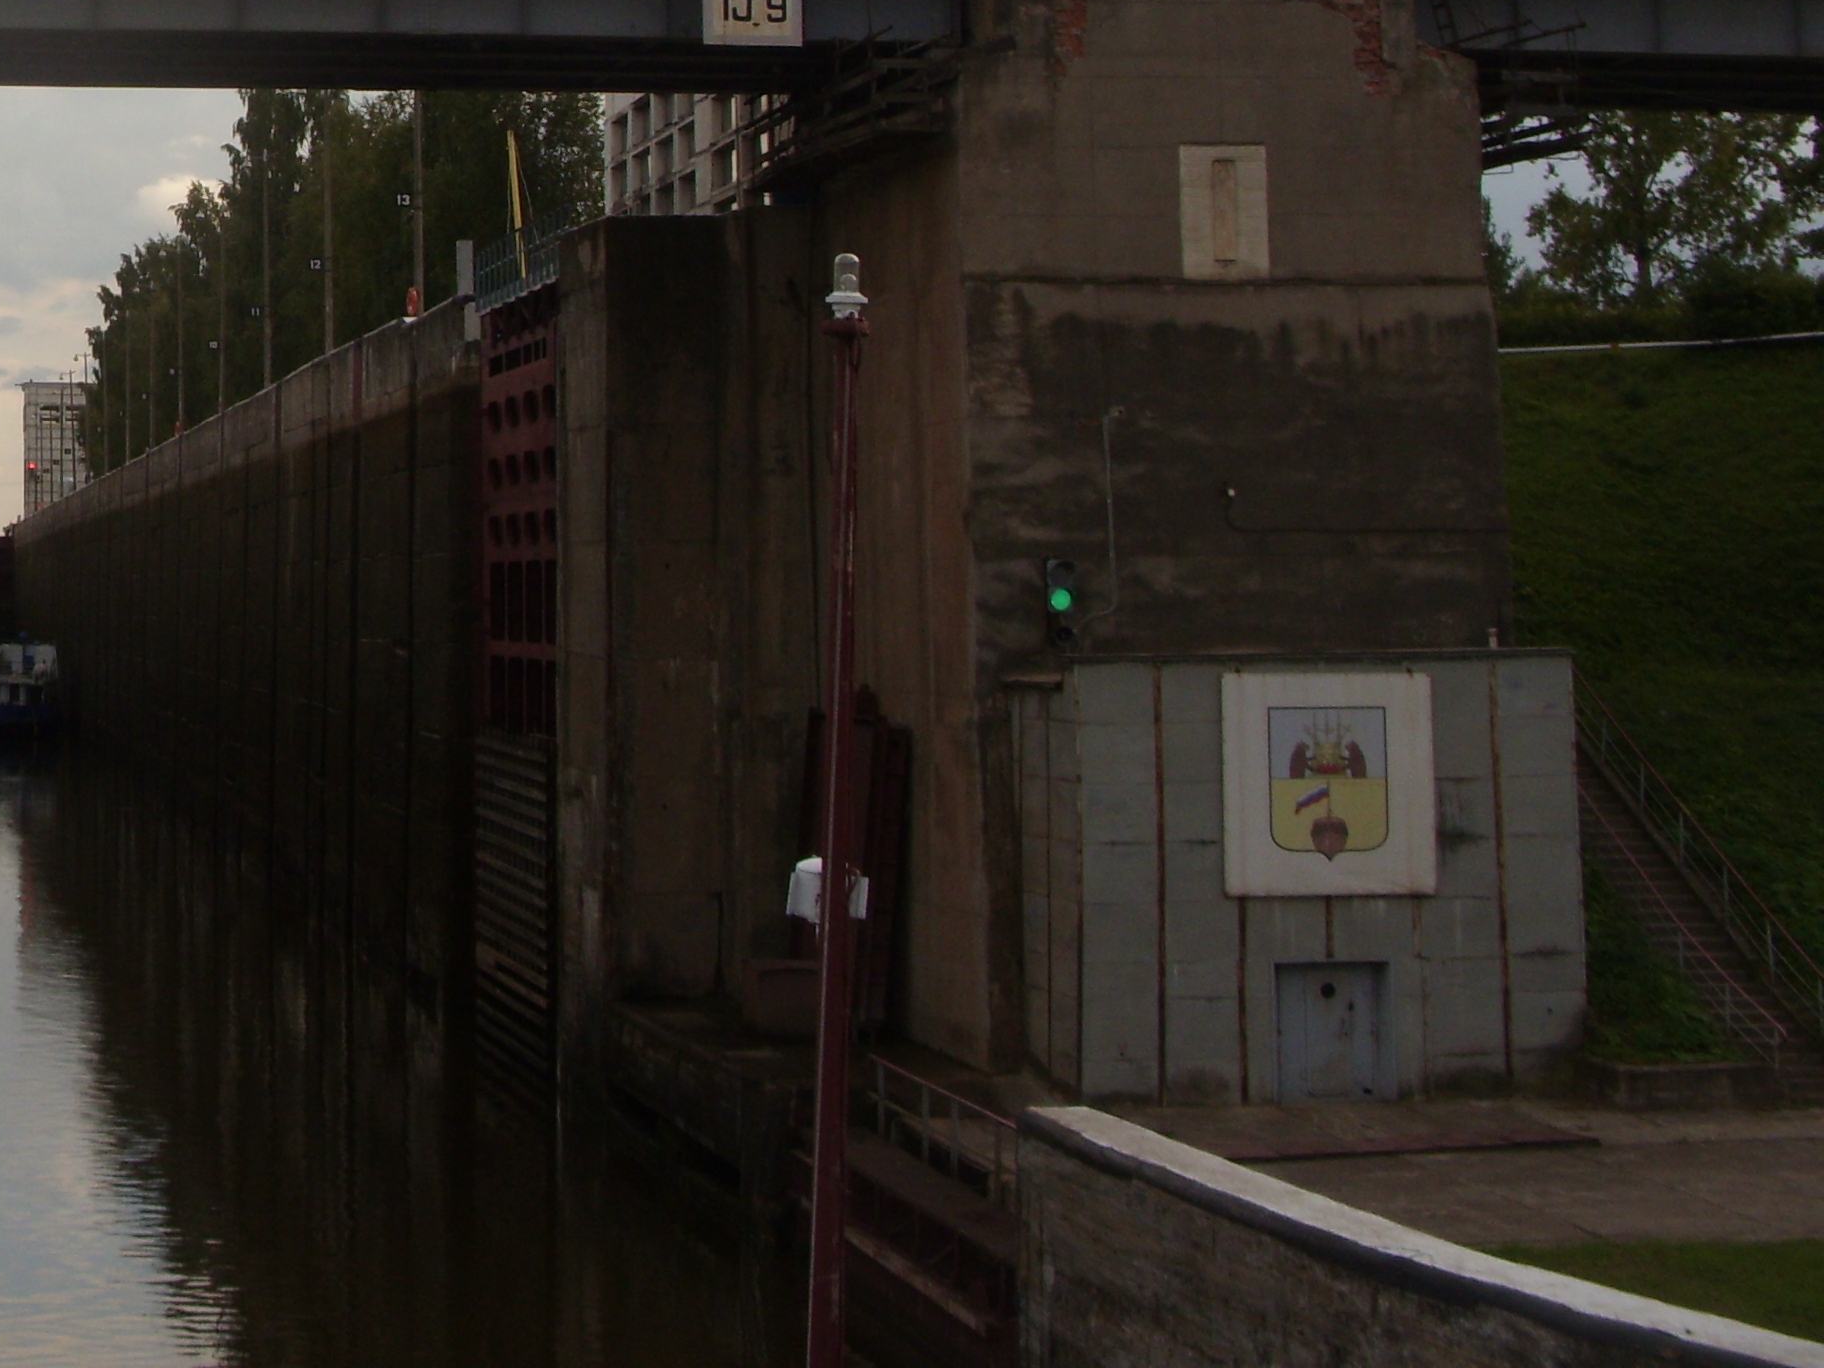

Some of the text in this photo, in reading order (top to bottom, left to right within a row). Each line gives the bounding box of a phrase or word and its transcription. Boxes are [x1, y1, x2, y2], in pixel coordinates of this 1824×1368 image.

[396, 194, 411, 206] 13
[310, 259, 322, 270] 12
[251, 307, 260, 317] 11
